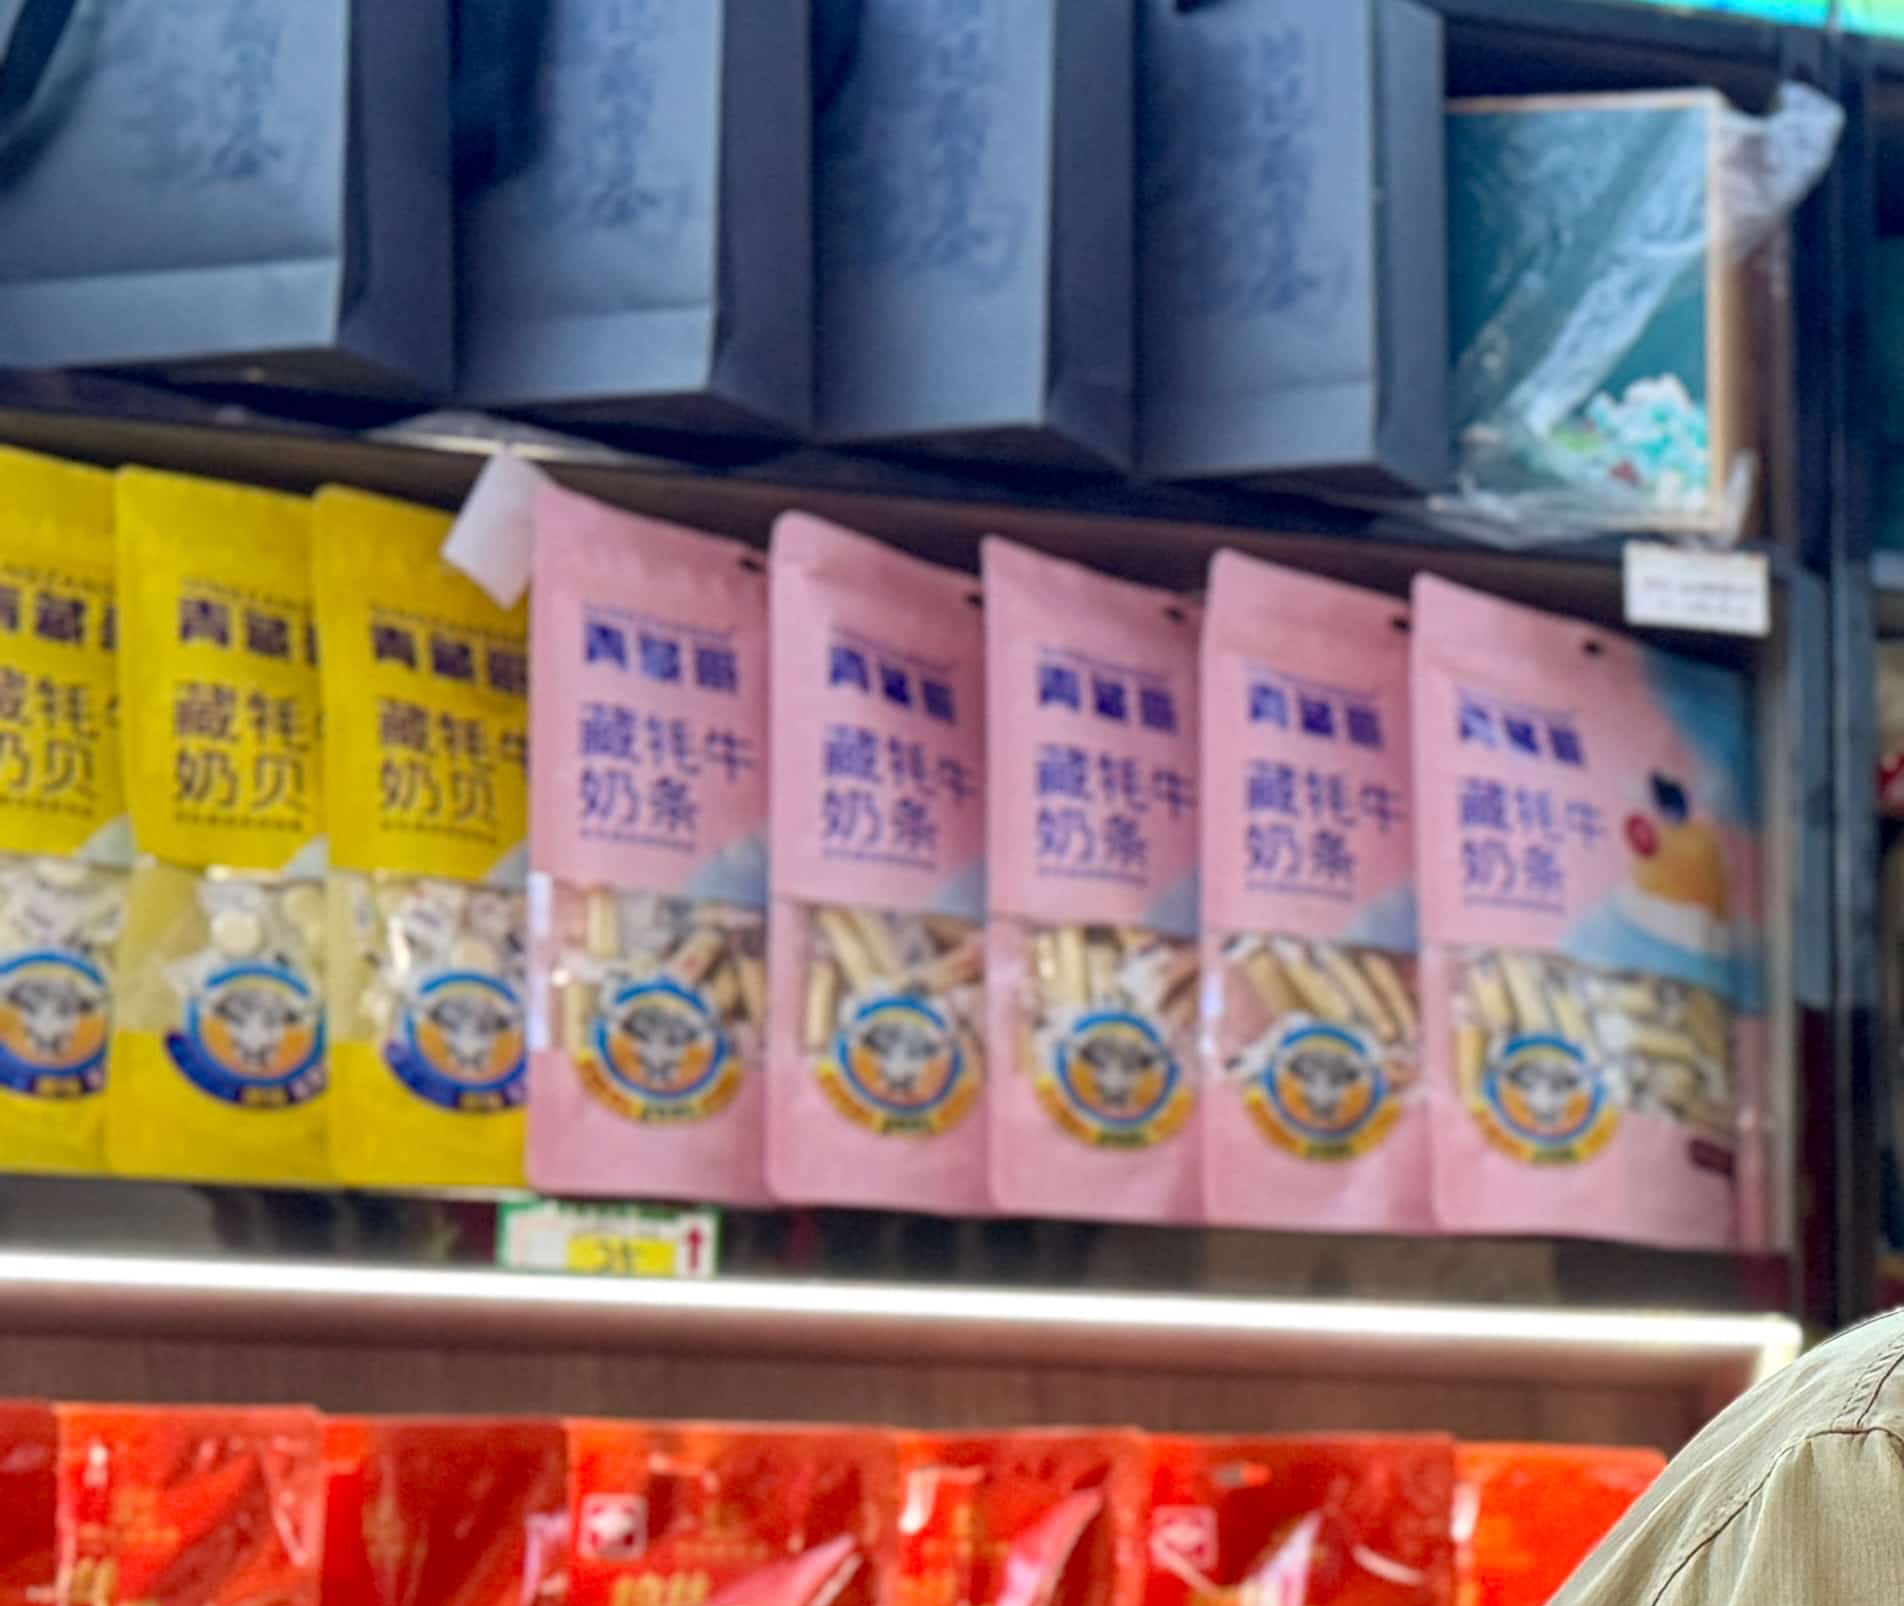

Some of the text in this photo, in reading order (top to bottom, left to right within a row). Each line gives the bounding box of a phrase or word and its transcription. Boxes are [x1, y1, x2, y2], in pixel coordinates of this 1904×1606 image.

[173, 682, 324, 752] 藏牦
[578, 704, 756, 782] 藏牦牛
[174, 752, 309, 812] 奶贝
[380, 765, 498, 825] 奶贝
[825, 724, 978, 803] 藏牦牛
[1034, 745, 1198, 822] 藏牦牛
[578, 769, 699, 832] 奶条
[822, 789, 938, 850] 奶条
[1243, 761, 1406, 835] 藏牦牛
[1457, 779, 1608, 848] 藏牦牛
[1034, 808, 1149, 867] 奶条
[1246, 825, 1357, 880] 奶条
[1457, 842, 1567, 894] 奶条
